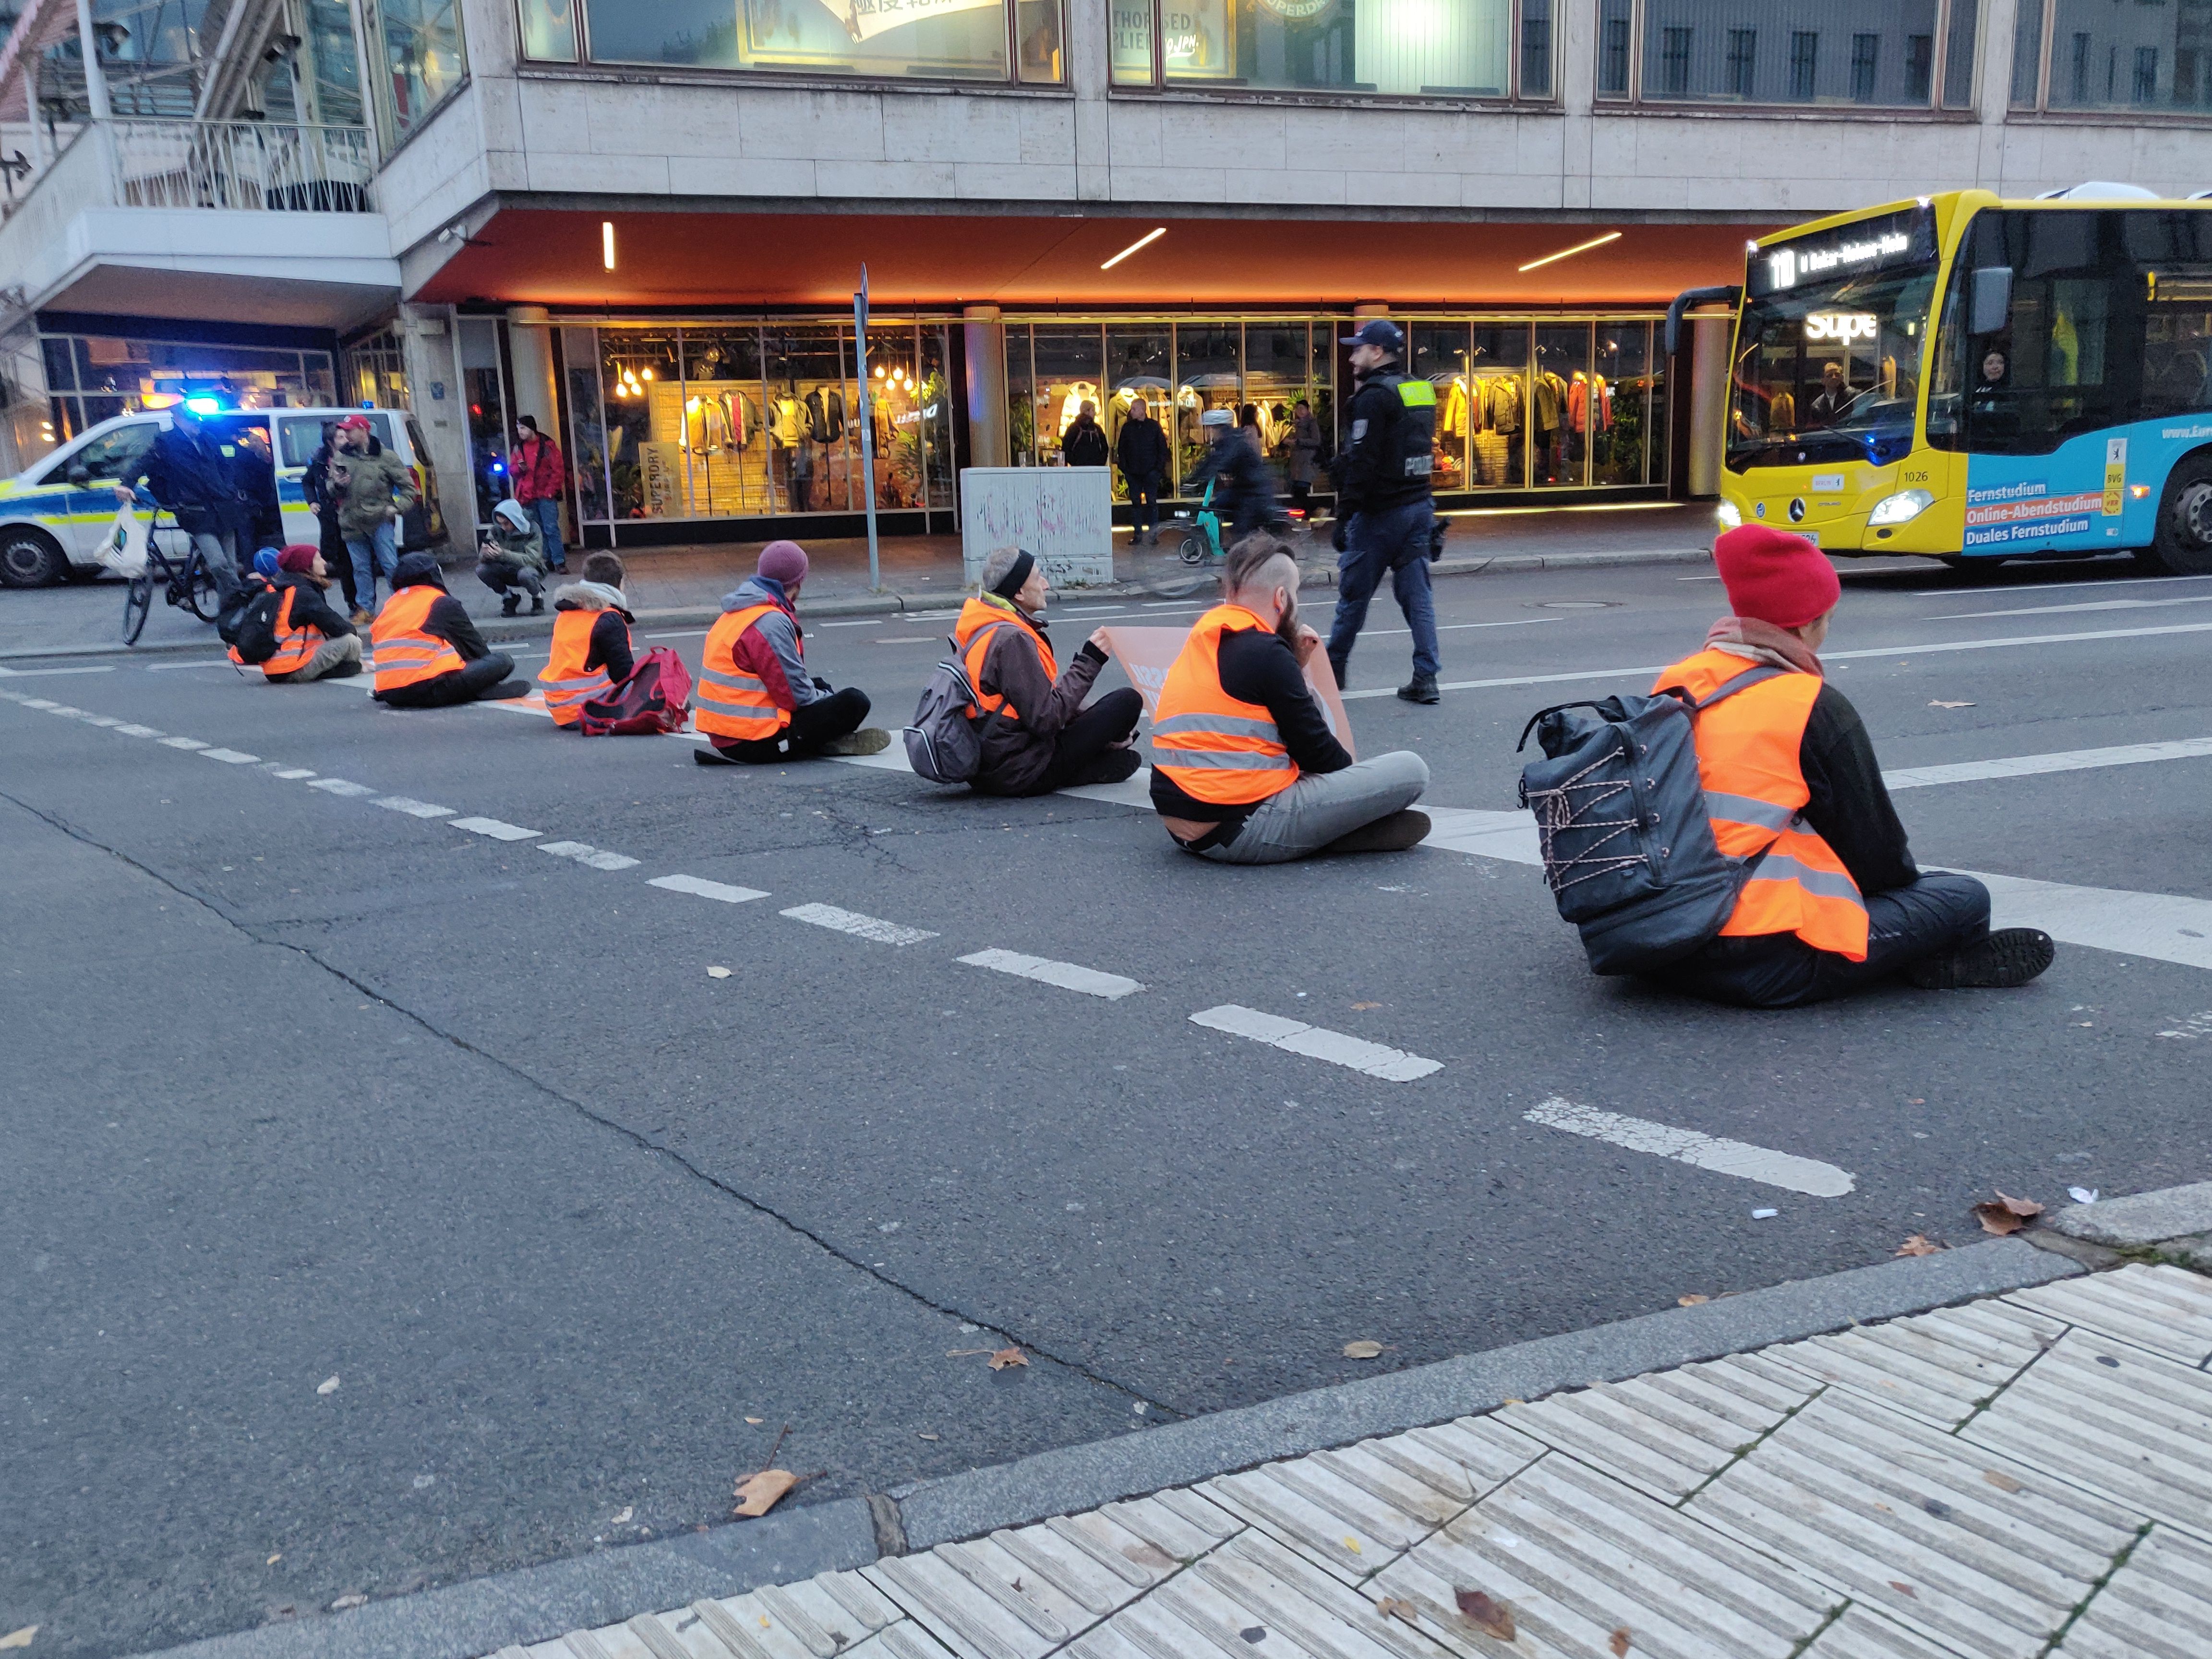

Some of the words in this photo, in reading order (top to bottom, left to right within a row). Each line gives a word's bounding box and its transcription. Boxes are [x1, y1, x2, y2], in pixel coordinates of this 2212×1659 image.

[1771, 250, 1795, 289] 110
[1904, 471, 1928, 482] 1026
[1968, 481, 2046, 503] Fernstudium
[1967, 497, 2102, 524] Online-Abendstudium
[1966, 529, 2009, 545] Duales
[2011, 518, 2089, 540] Fernstudium
